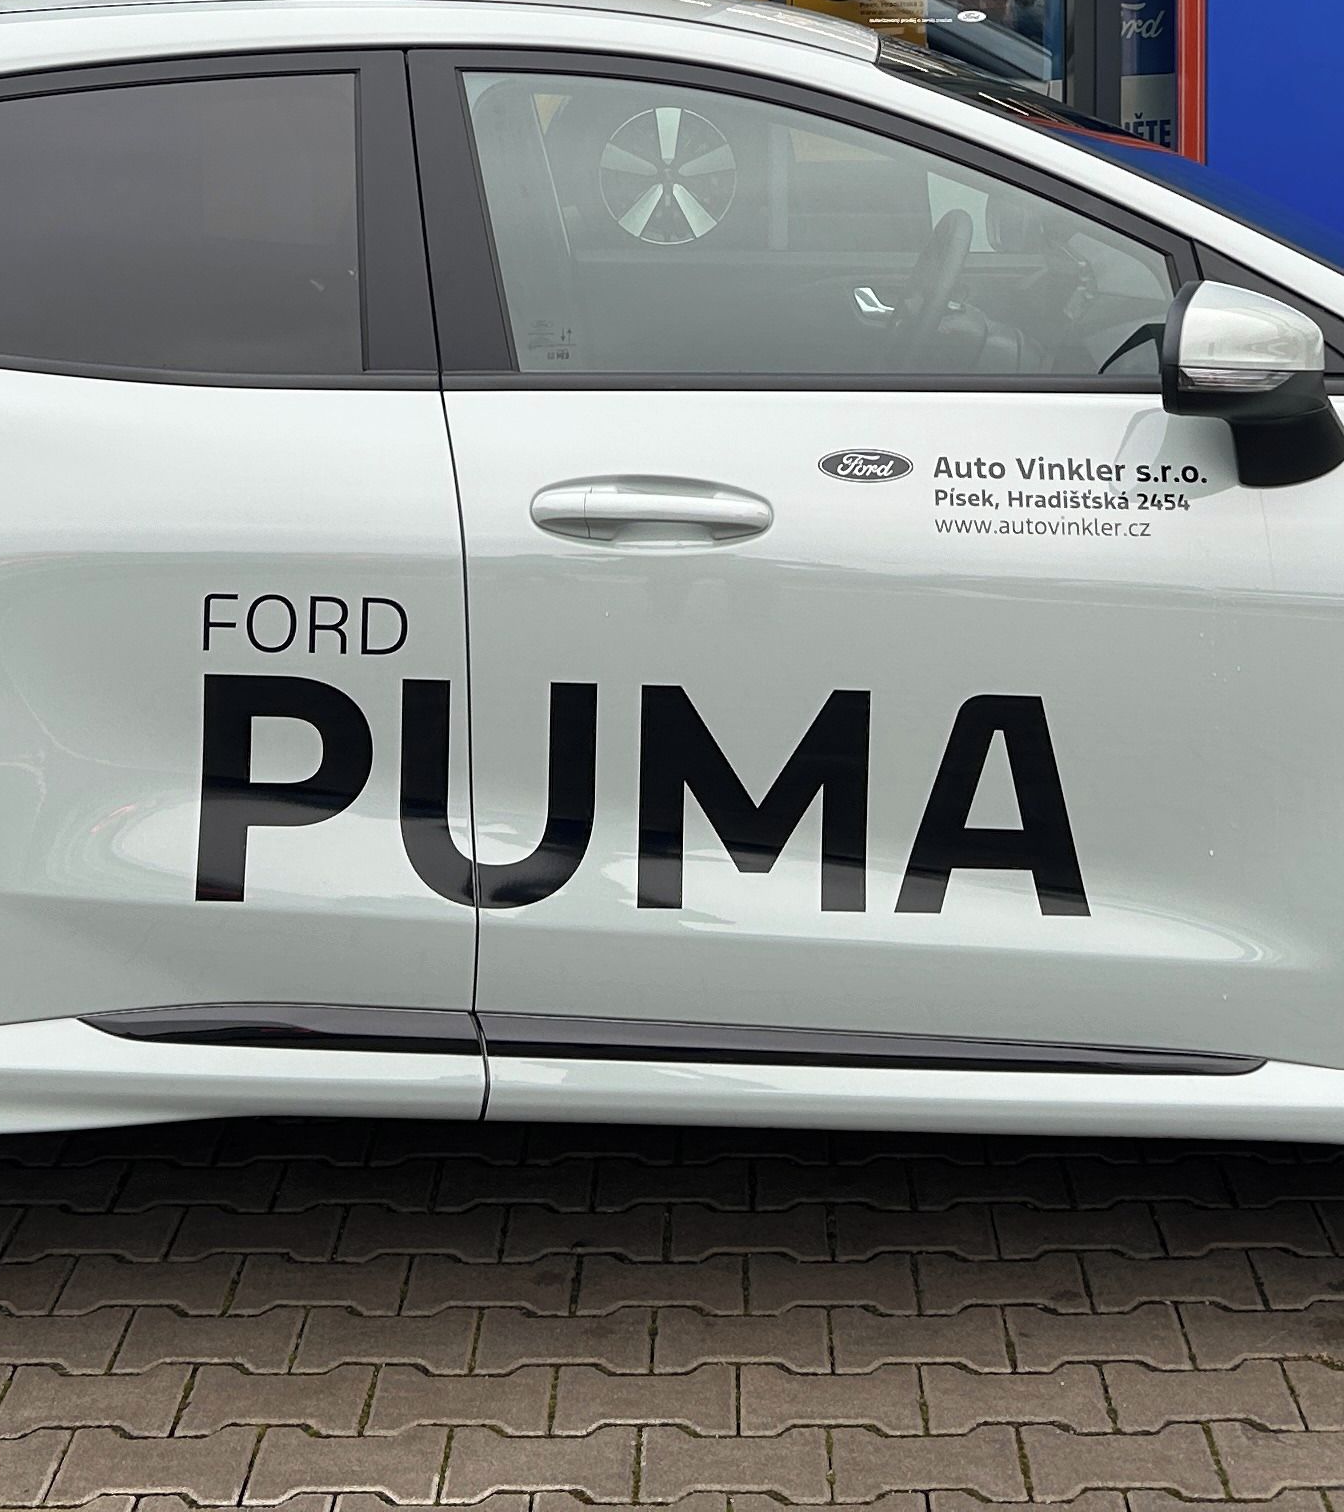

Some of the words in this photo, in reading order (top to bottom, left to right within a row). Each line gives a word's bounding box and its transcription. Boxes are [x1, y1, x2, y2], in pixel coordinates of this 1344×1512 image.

[836, 453, 895, 478] Ford
[933, 455, 1007, 481] Auto
[1016, 456, 1126, 483] Vinkler
[1136, 462, 1209, 484] s.r.o.
[934, 488, 1001, 511] Písek,
[1008, 489, 1130, 511] Hradišťská
[1137, 492, 1191, 513] 2454
[934, 517, 1152, 539] www.autovinkler.cz
[202, 593, 409, 656] FORD
[195, 673, 1092, 916] PUMA
